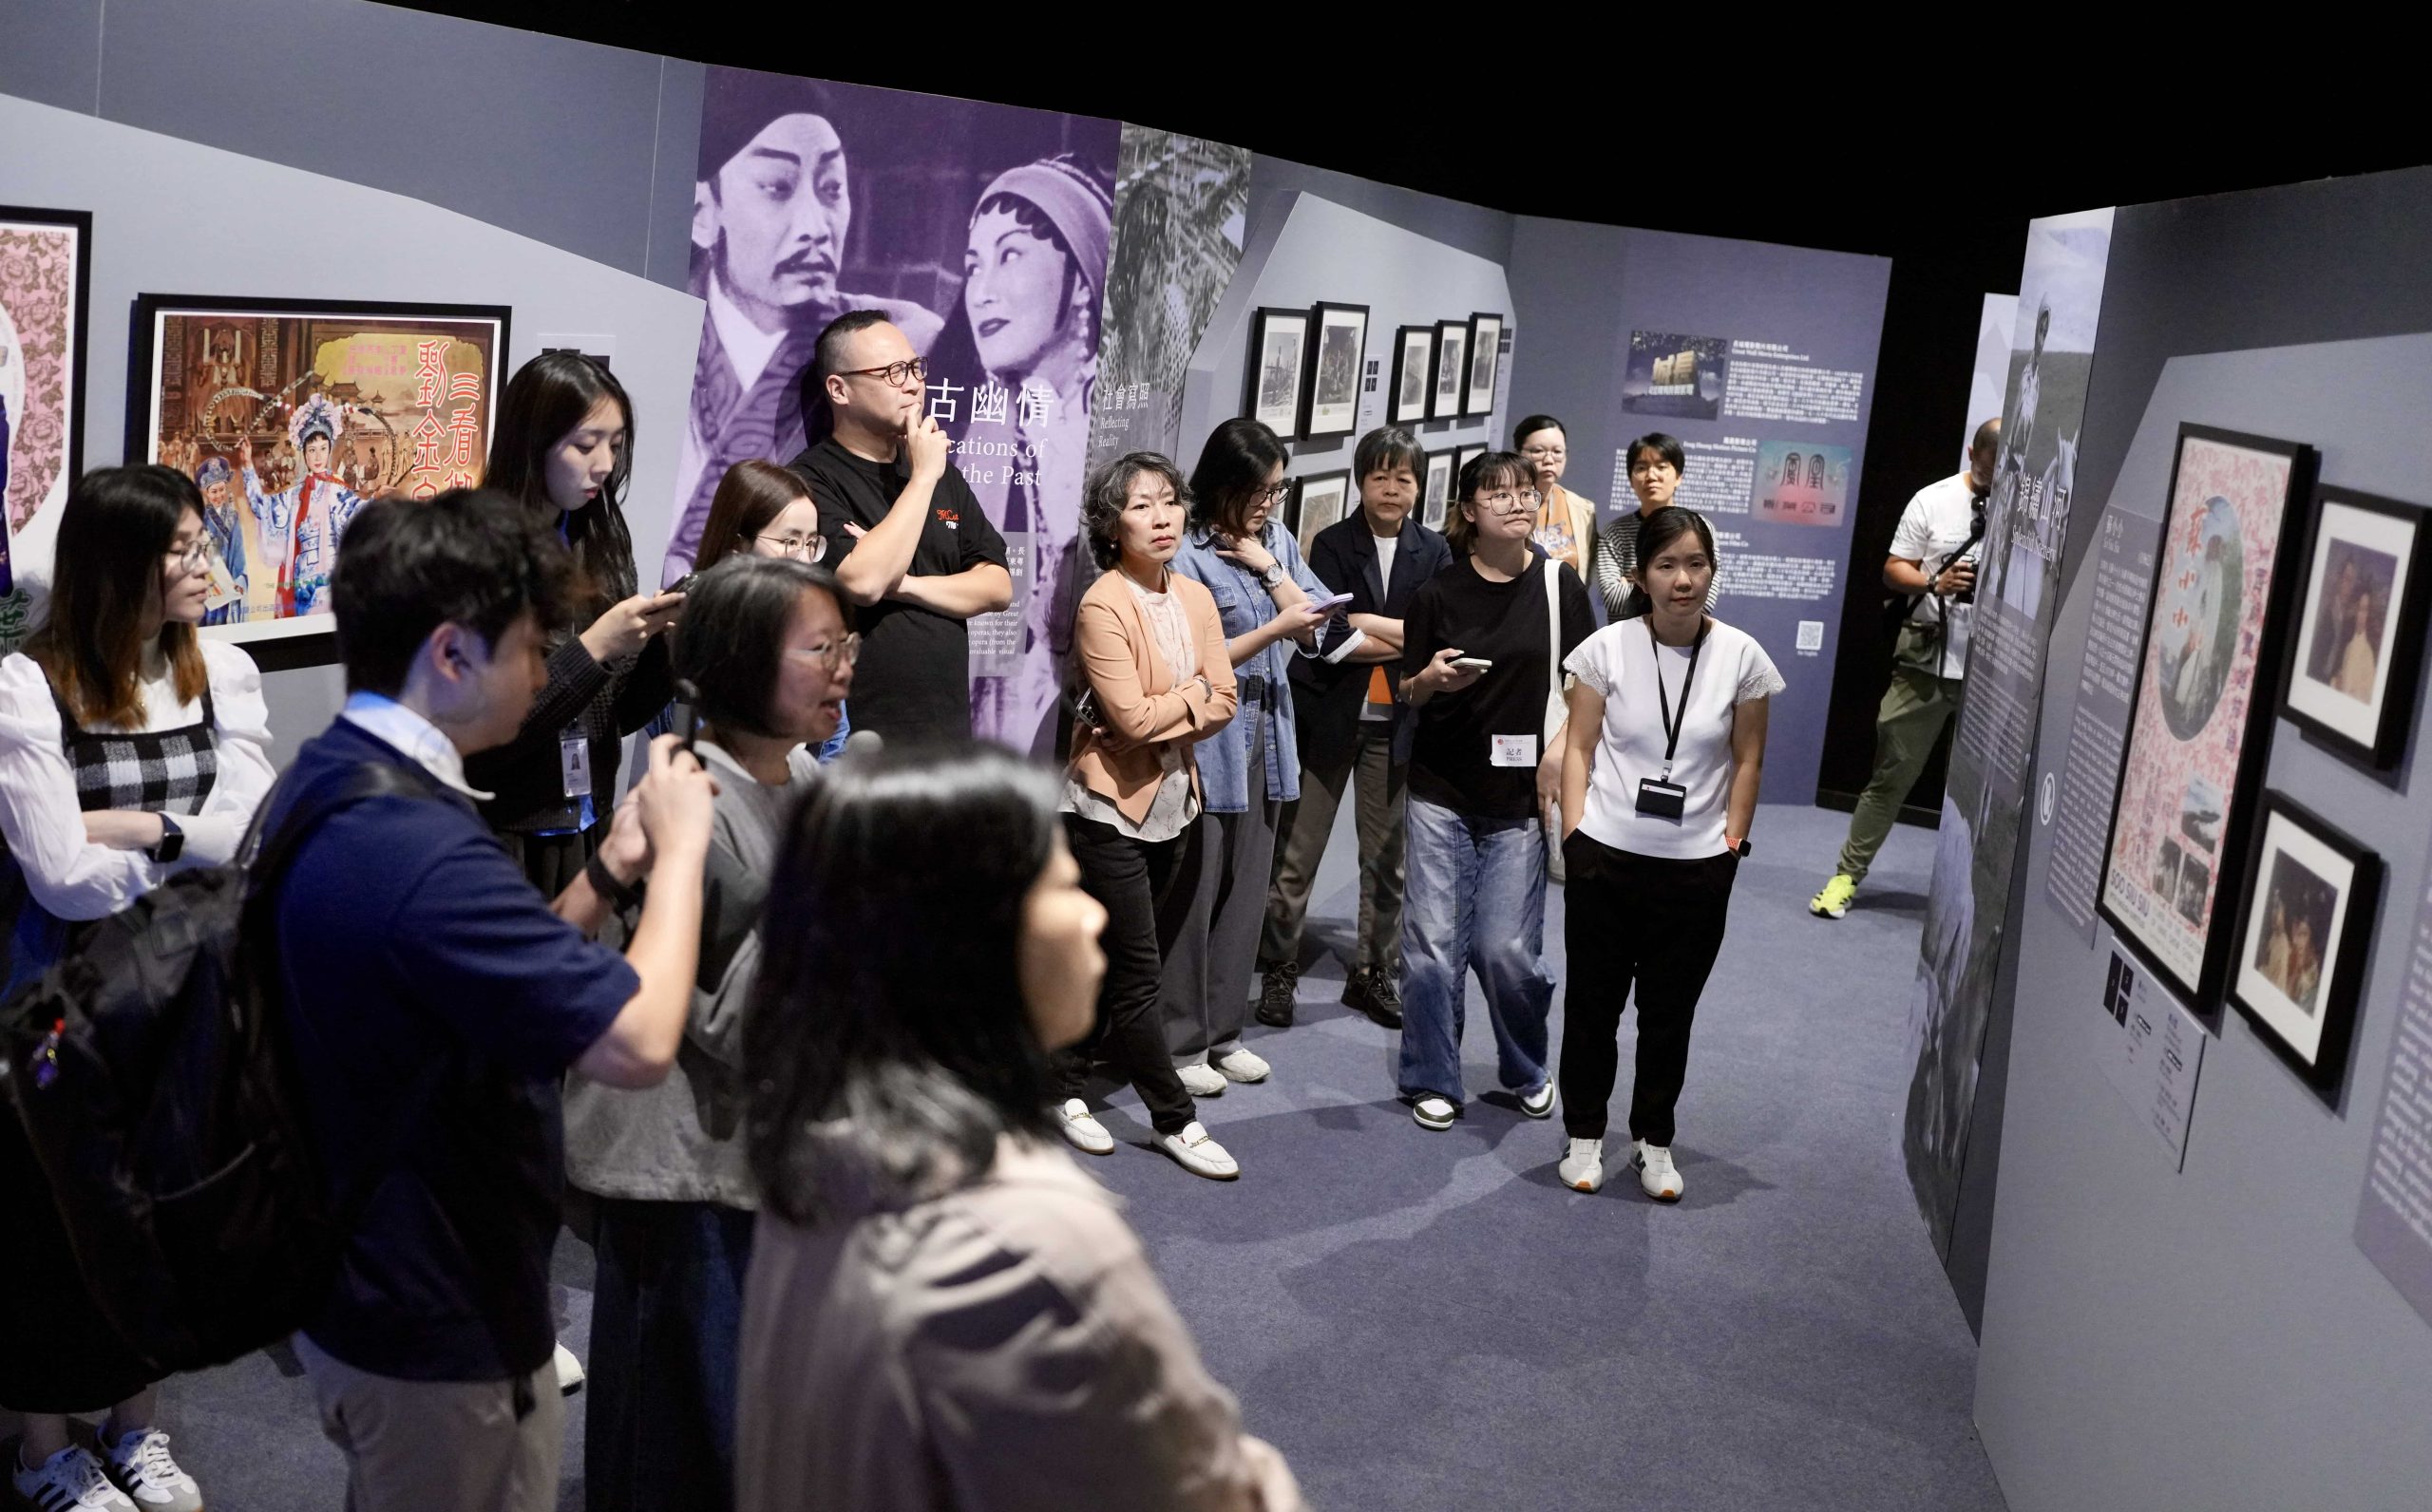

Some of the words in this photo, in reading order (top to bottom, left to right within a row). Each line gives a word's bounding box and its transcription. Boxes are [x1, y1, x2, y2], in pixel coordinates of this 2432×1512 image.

[1102, 382, 1150, 411] 社會寫照
[1101, 415, 1130, 431] Reflecting
[1025, 438, 1048, 458] of
[1098, 434, 1119, 449] Reality
[962, 463, 993, 483] the
[1000, 465, 1041, 485] Past
[2017, 473, 2067, 531] 錦繡山河
[2011, 524, 2036, 556] Splendid
[2034, 535, 2058, 569] Scenery
